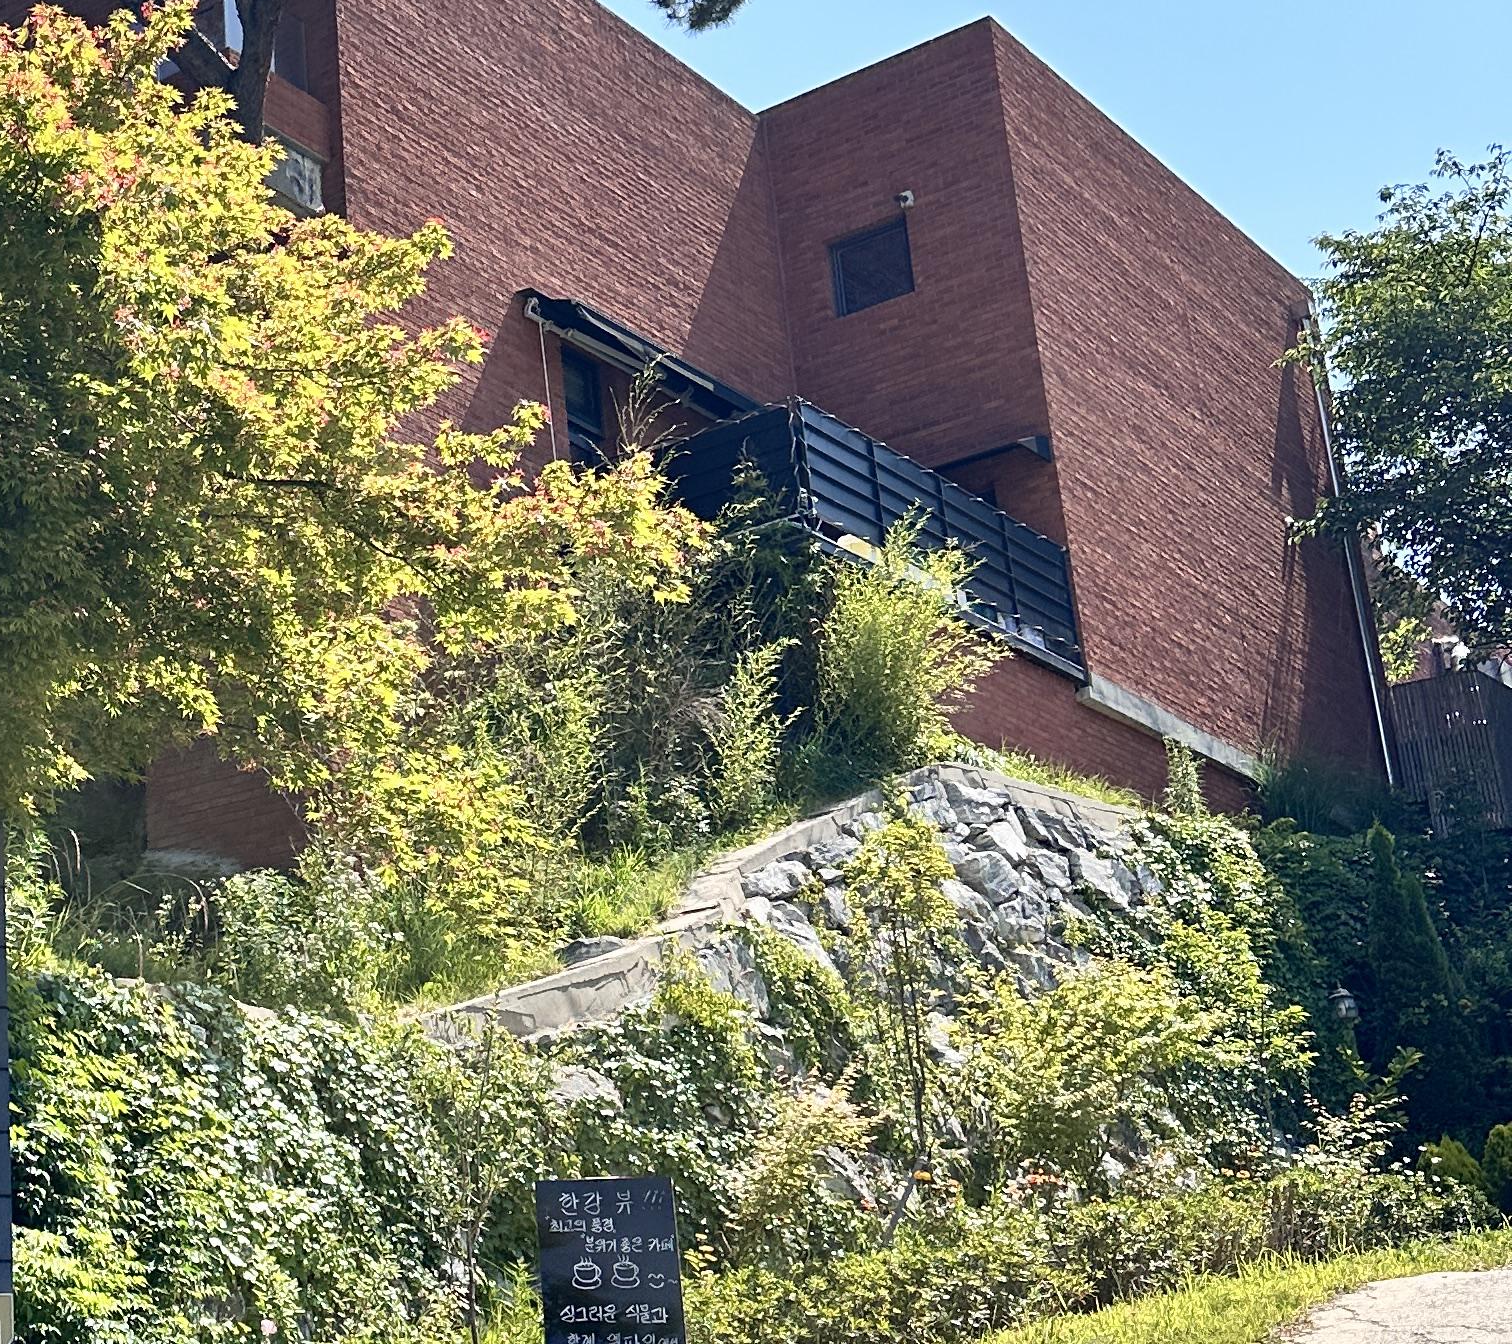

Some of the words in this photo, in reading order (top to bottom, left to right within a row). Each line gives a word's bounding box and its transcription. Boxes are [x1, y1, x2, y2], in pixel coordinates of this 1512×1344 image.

[559, 1191, 603, 1215] 한강
[615, 1189, 634, 1215] 뷰
[559, 1303, 617, 1324] 싱그러운
[625, 1303, 669, 1324] 식물과
